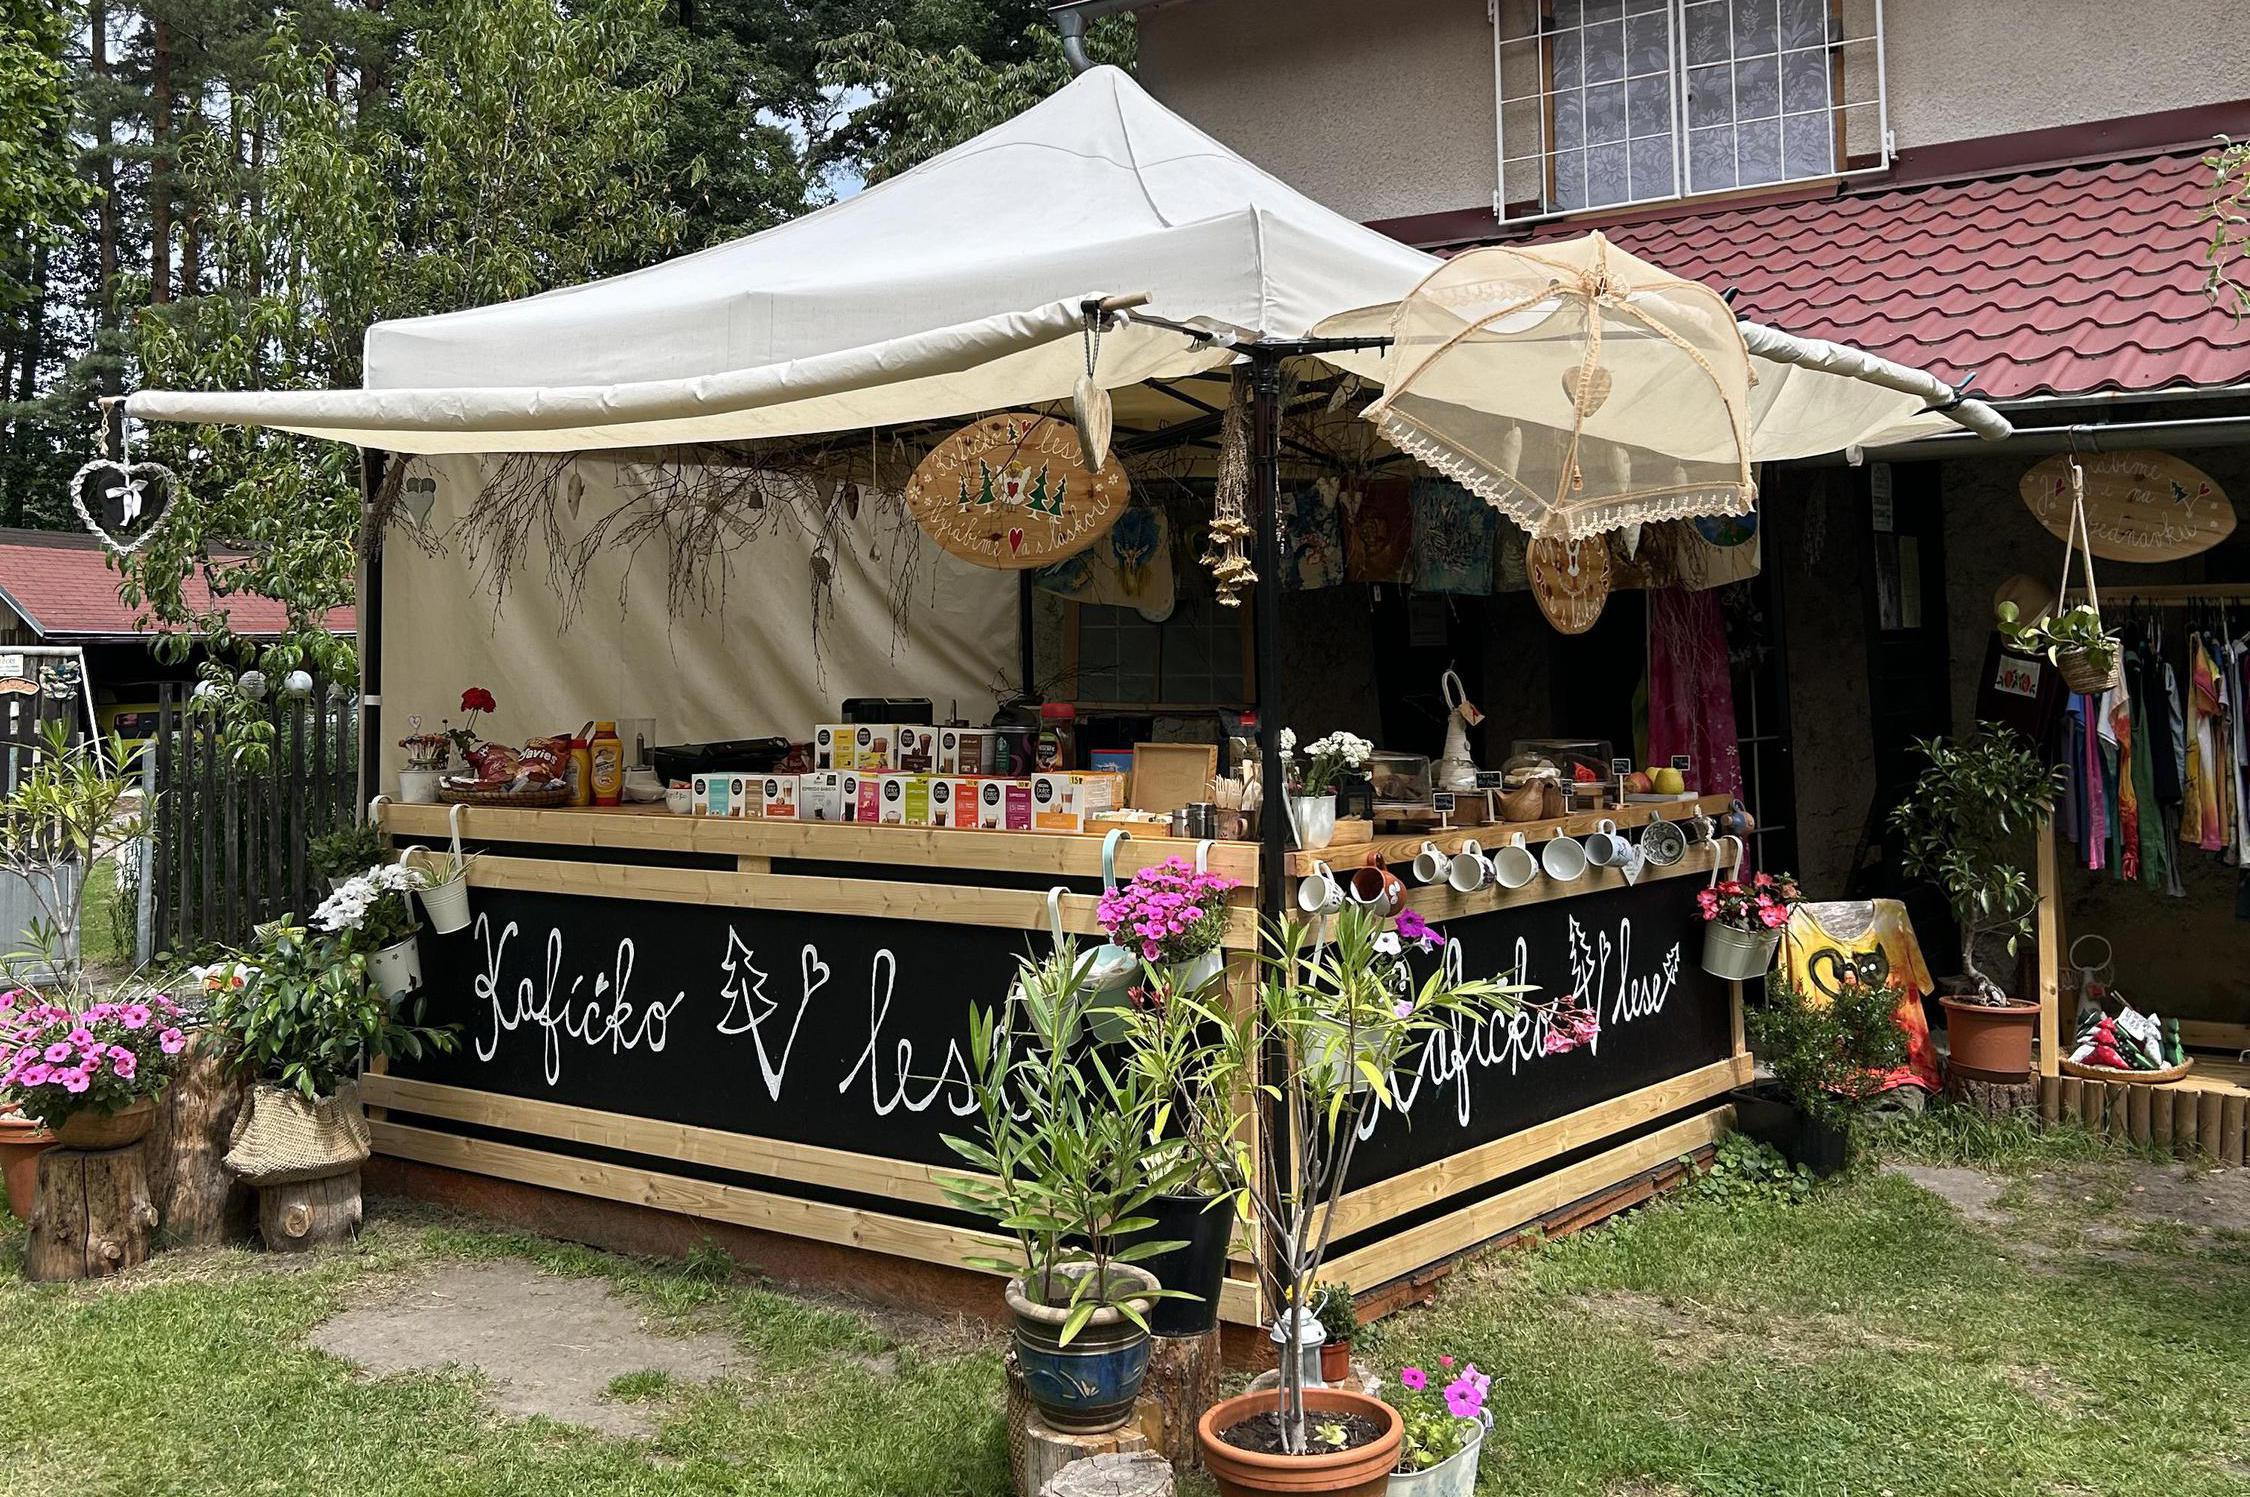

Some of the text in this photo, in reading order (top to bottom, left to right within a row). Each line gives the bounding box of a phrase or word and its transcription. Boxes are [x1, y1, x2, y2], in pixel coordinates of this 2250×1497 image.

[1036, 424, 1085, 467] lese
[474, 911, 685, 1086] Kafíčko
[1611, 917, 1673, 1025] lese
